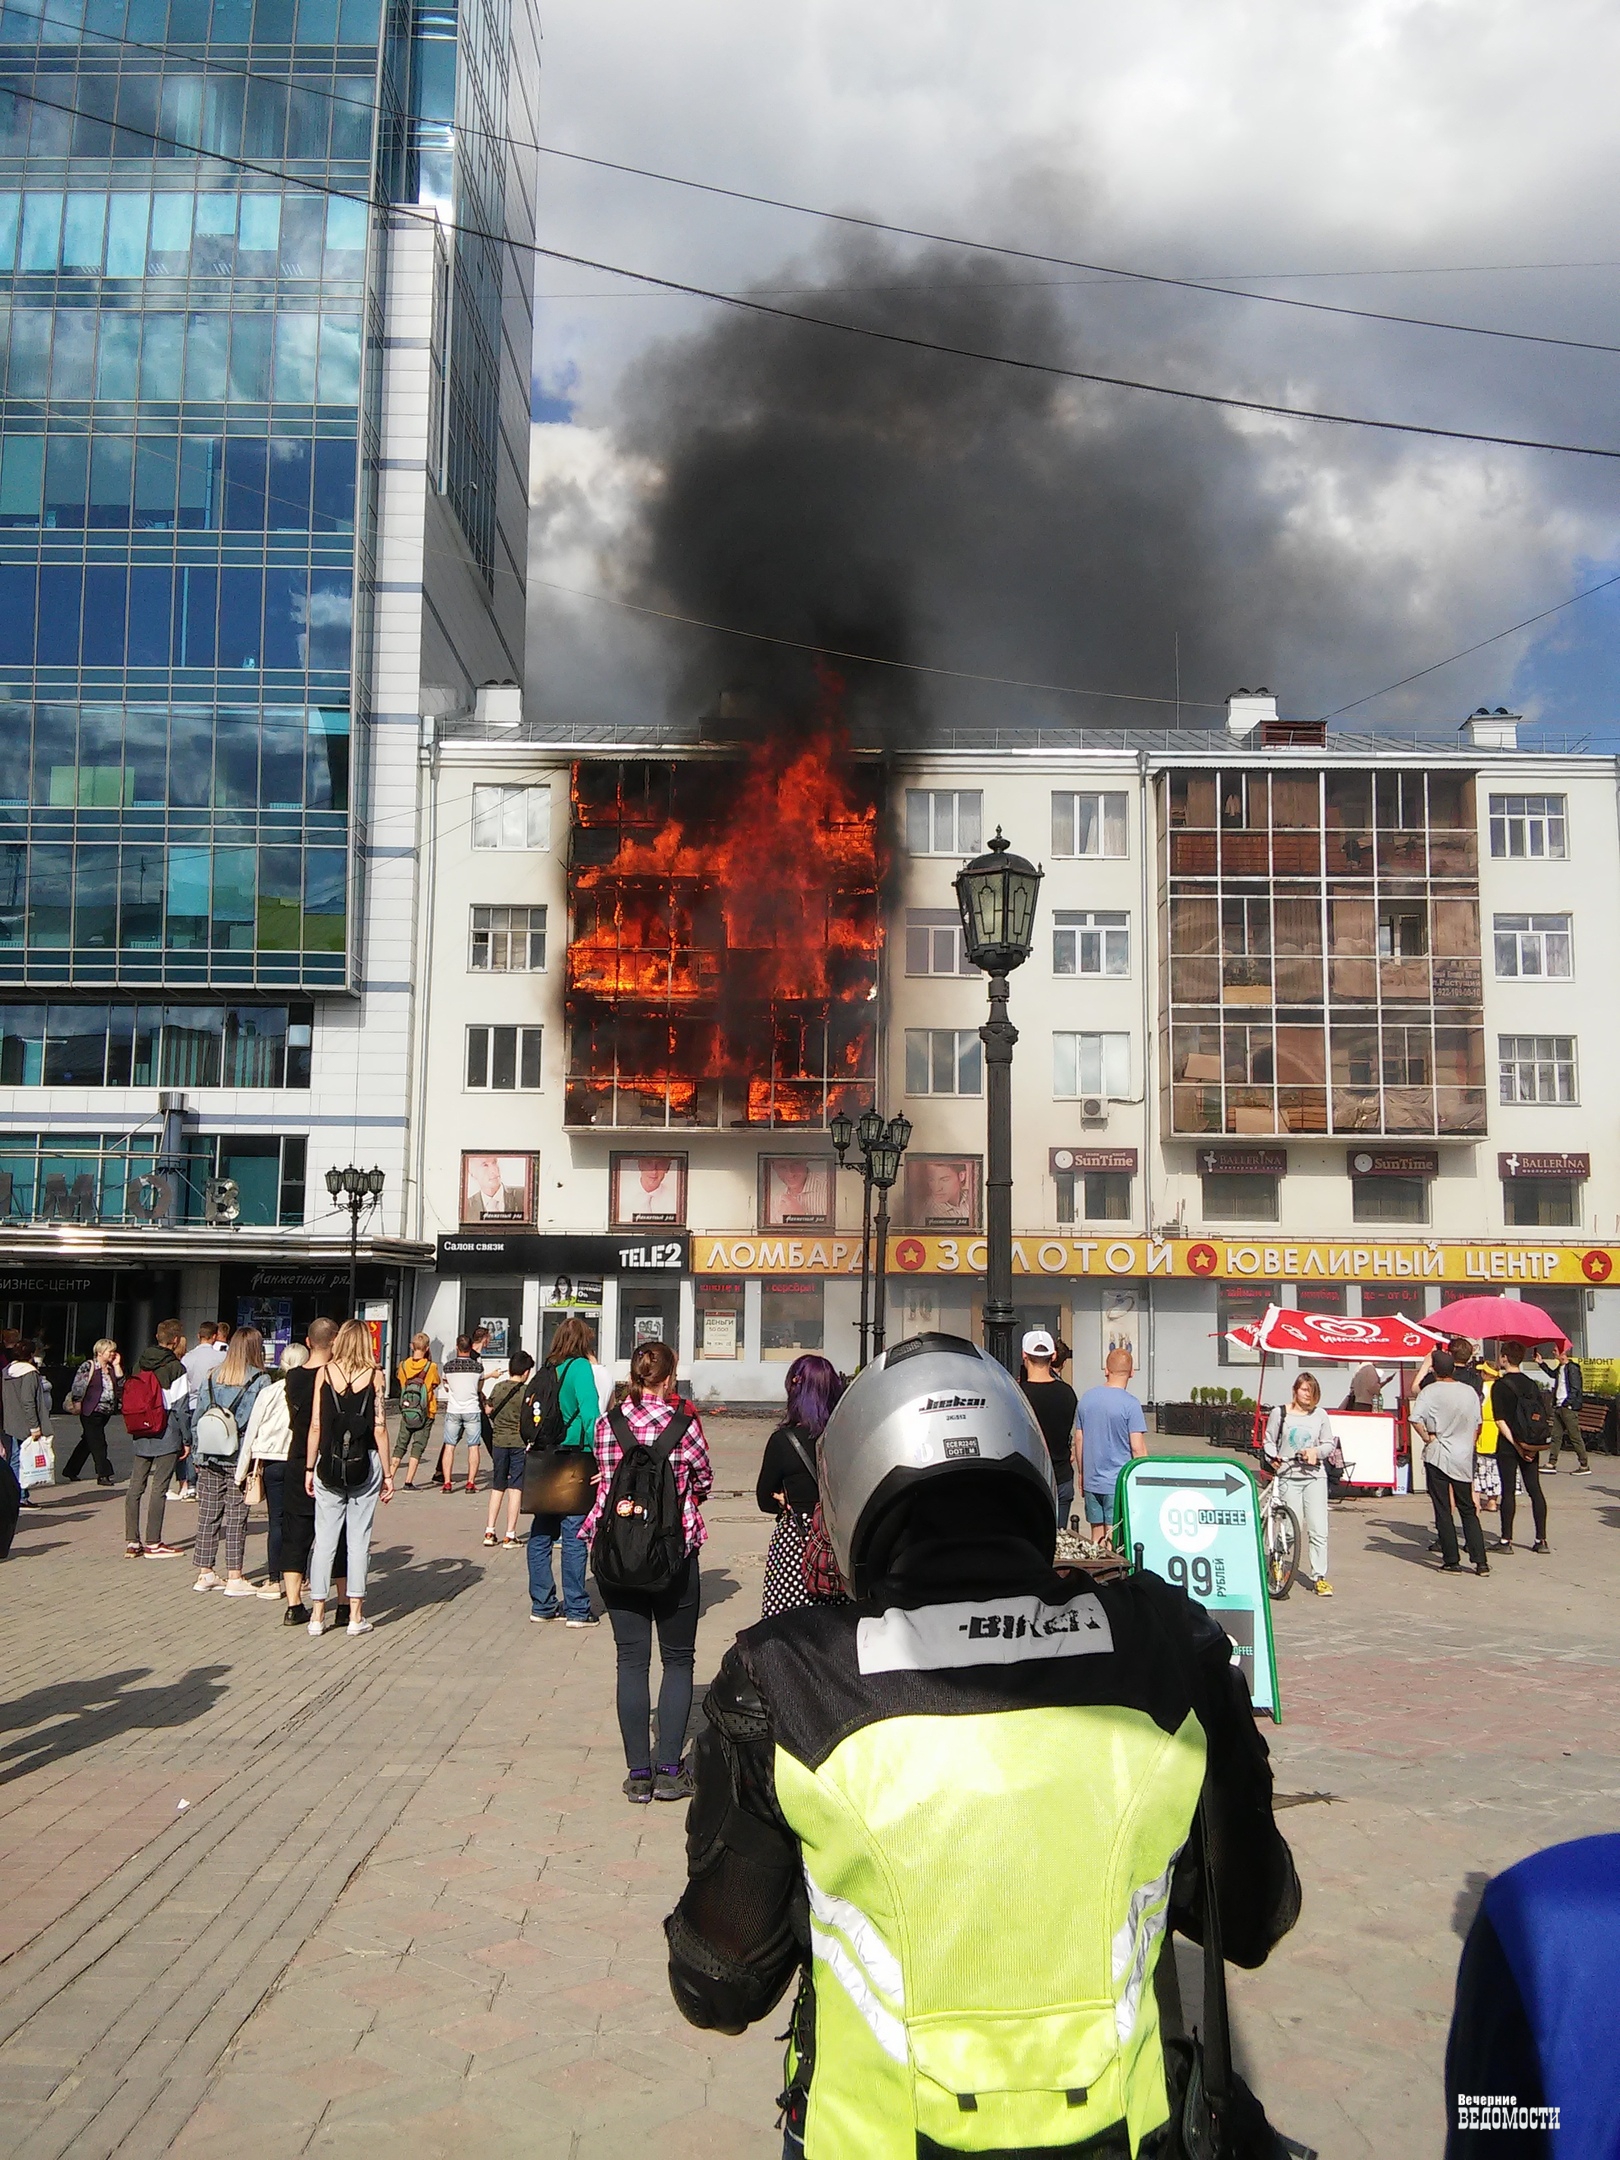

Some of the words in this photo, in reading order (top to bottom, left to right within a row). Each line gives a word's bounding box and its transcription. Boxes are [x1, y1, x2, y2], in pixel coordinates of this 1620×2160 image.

[1075, 1154, 1133, 1167] SunTime
[1220, 1153, 1282, 1166] BALLERINA
[1375, 1157, 1433, 1170] SunTime
[1522, 1155, 1585, 1168] BALLERINA
[0, 1172, 240, 1221] МОВ
[443, 1241, 474, 1251] Салон
[475, 1242, 504, 1251] связи
[619, 1242, 682, 1268] TELE2
[706, 1242, 874, 1272] ЛОМБАРД
[936, 1236, 1172, 1274] ЗОЛОТОЙ
[1226, 1242, 1444, 1277] ЮВЕЛИРНЫЙ
[1465, 1250, 1559, 1281] ЦЕНТР
[0, 1278, 91, 1292] ИЗНЕС-ЦЕНТР
[250, 1269, 326, 1291] Манжетный
[1577, 1357, 1614, 1366] РЕМОНТ
[948, 1448, 964, 1456] DOT
[1168, 1508, 1199, 1537] 99
[1198, 1509, 1246, 1525] COFFEE
[1167, 1556, 1213, 1597] 99
[1217, 1557, 1226, 1598] РУБЛЕЙ
